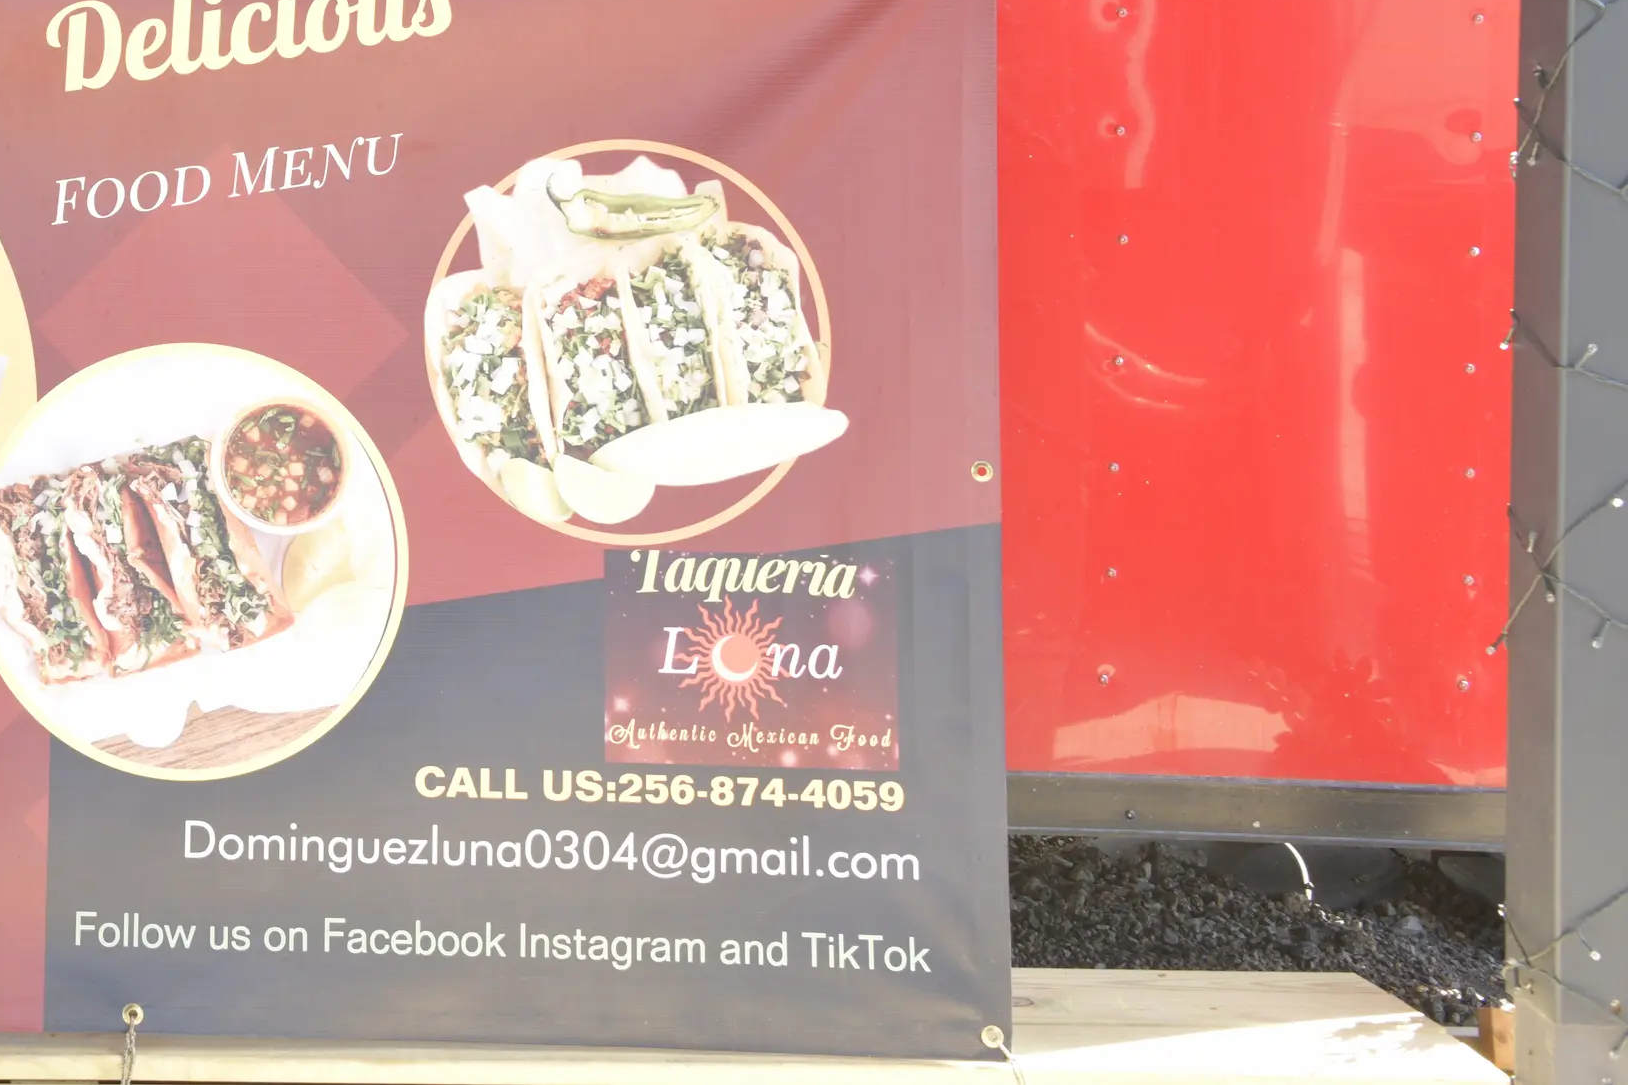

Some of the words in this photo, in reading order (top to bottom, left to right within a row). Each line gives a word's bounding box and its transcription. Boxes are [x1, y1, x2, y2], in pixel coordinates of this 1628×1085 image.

[51, 164, 211, 225] FOOD
[228, 133, 403, 198] MENU
[630, 549, 858, 603] Taqueria
[609, 718, 717, 750] Authentic
[727, 722, 820, 752] Mexican
[830, 723, 892, 751] Food
[415, 765, 528, 800] CALL
[183, 819, 921, 883] Dominguezluna0304@gmail.com
[75, 911, 197, 950] Follow
[208, 923, 252, 952] us
[263, 926, 308, 953] on
[323, 918, 506, 960] Facebook
[519, 923, 707, 967] Instagram
[720, 929, 789, 967] and
[802, 932, 931, 973] TikTok
